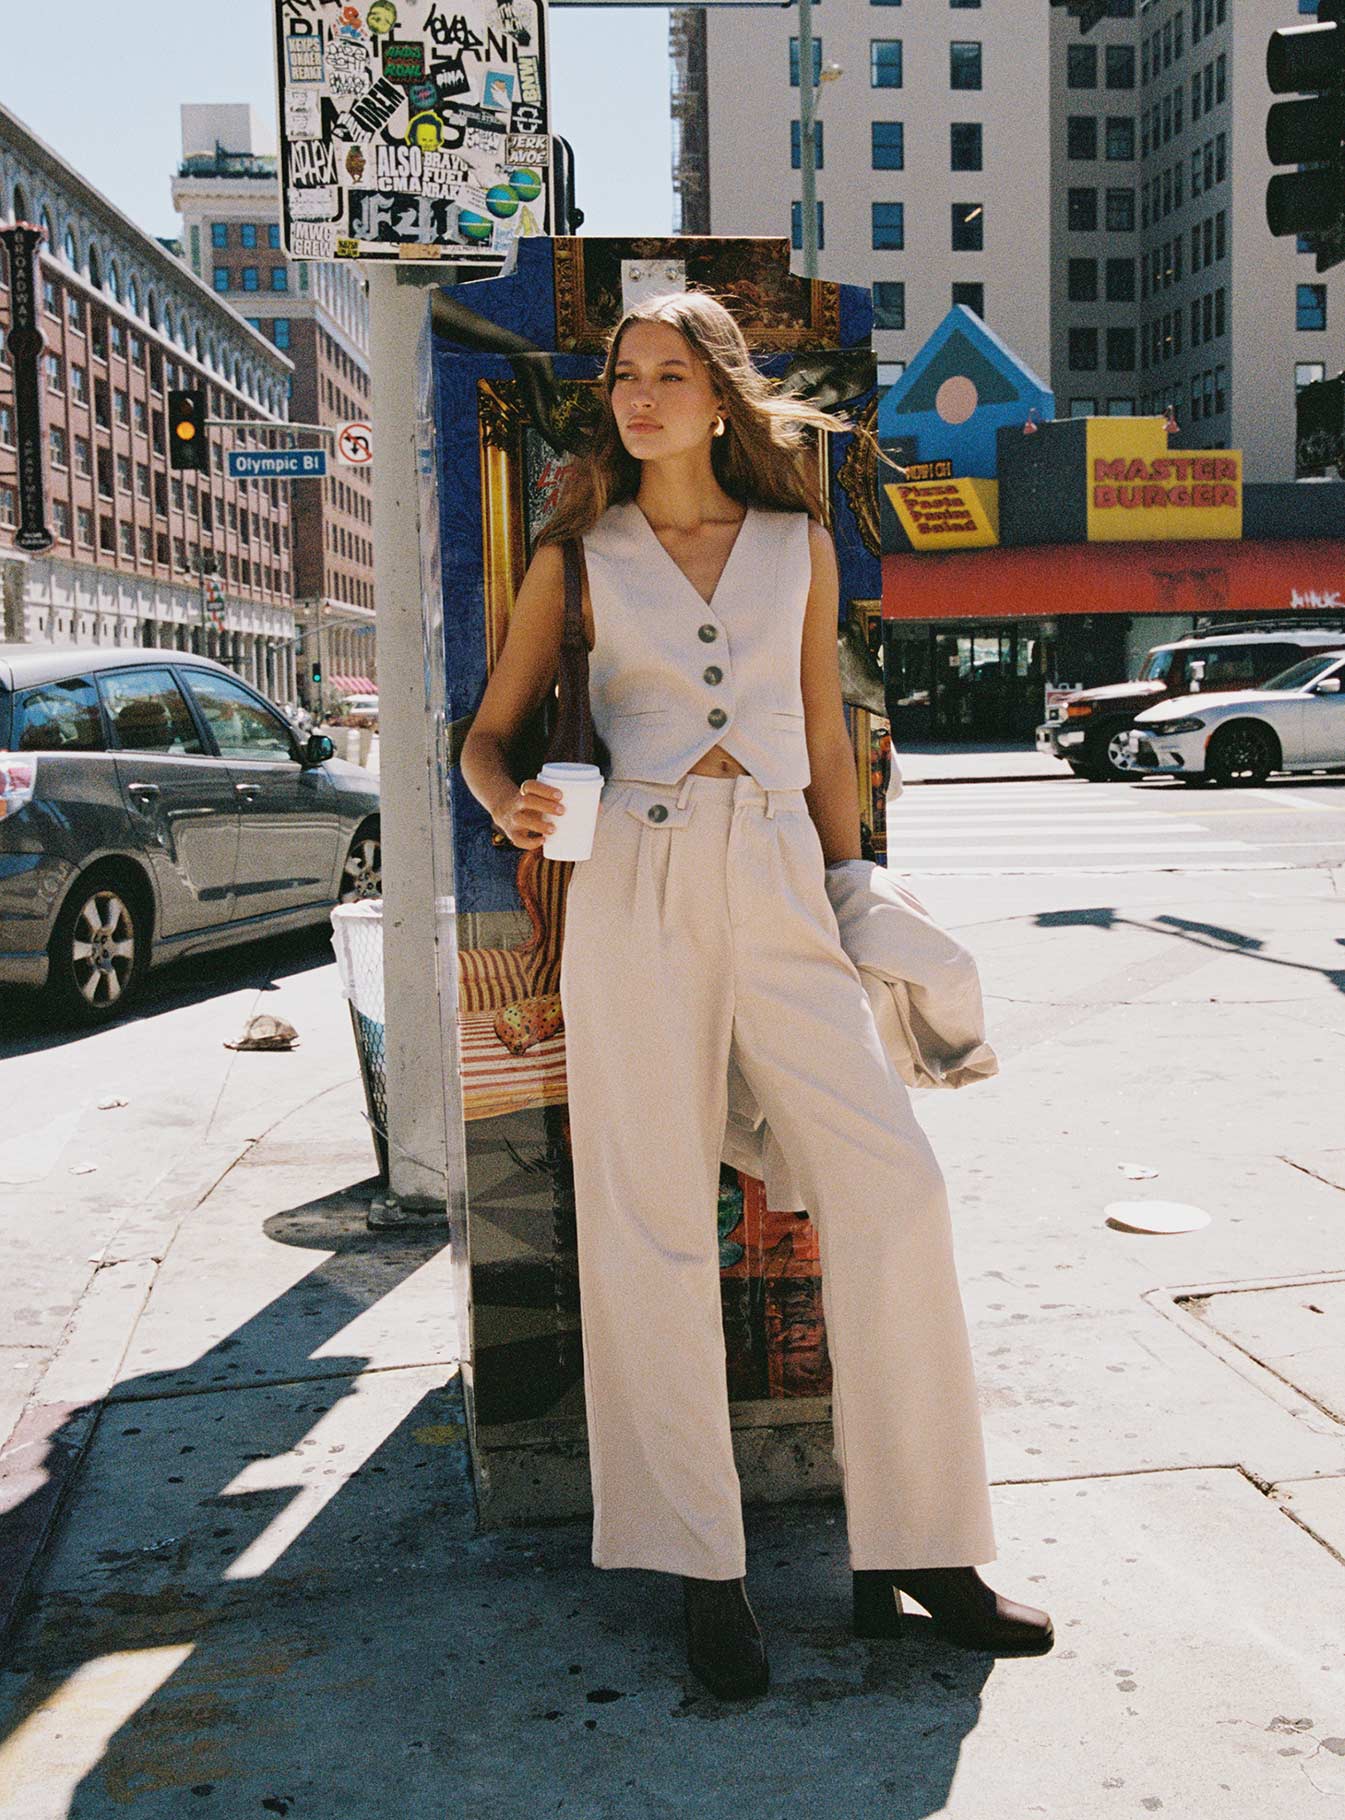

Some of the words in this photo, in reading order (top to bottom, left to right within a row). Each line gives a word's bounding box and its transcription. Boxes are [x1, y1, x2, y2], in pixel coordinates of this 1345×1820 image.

[377, 145, 422, 177] ALSO
[236, 456, 298, 474] Olympic
[303, 455, 319, 470] Bl
[1095, 458, 1237, 482] MASTER
[1094, 484, 1237, 509] BURGER
